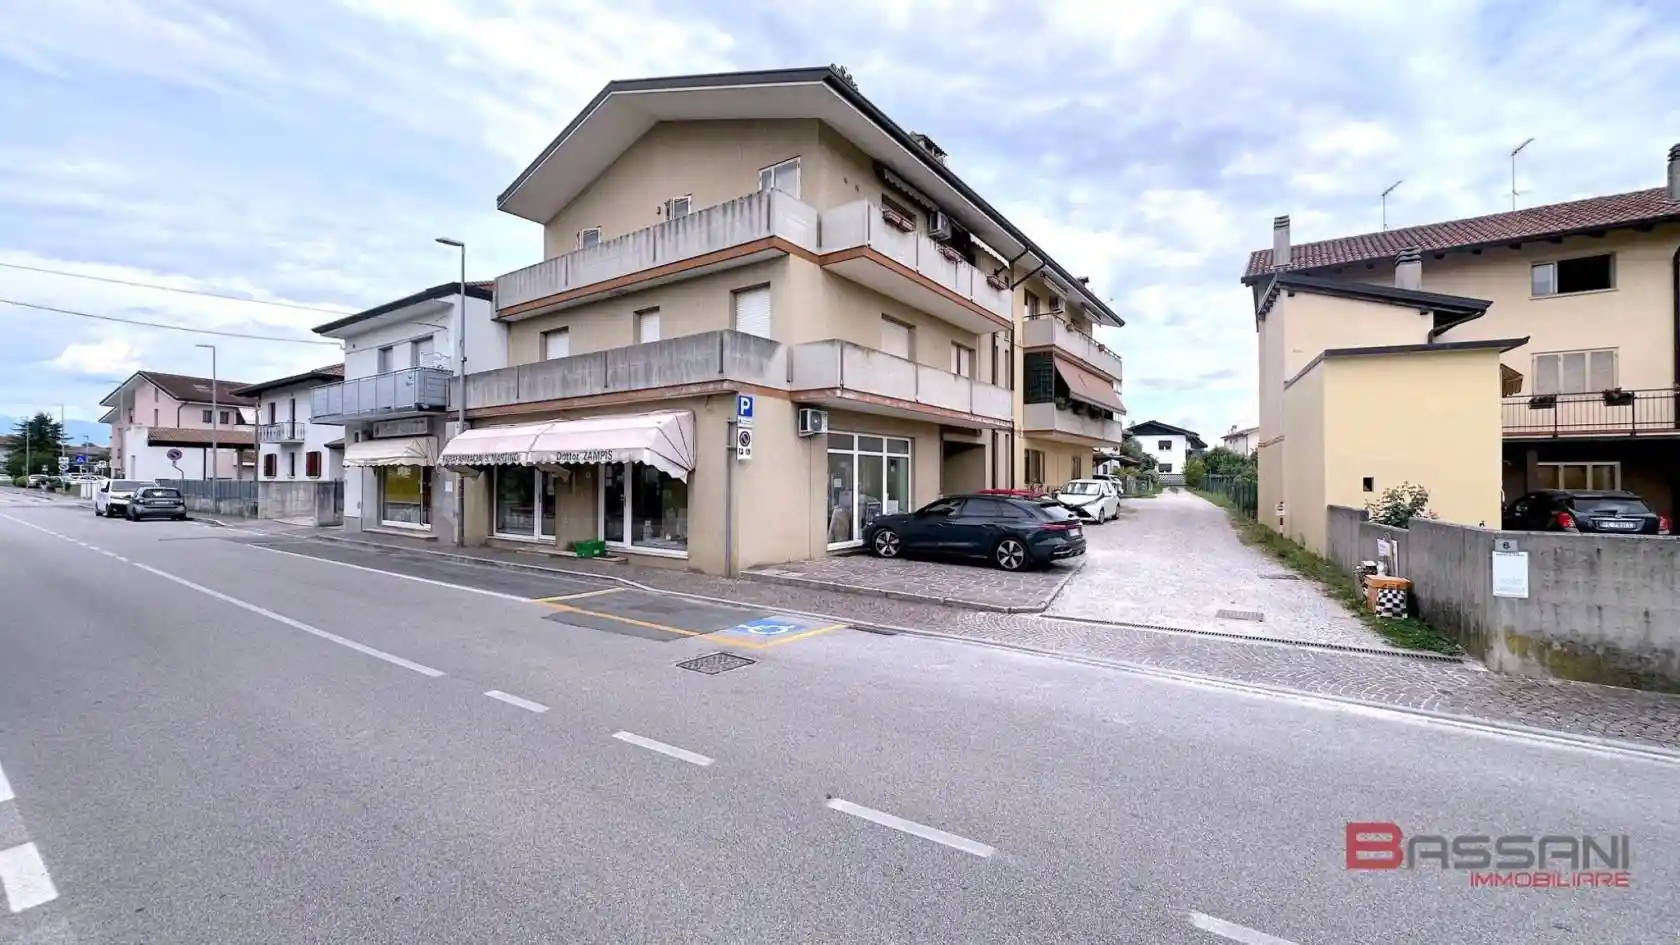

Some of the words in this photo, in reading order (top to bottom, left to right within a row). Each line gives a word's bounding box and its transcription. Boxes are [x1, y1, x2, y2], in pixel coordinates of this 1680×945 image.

[740, 397, 750, 415] P
[491, 451, 519, 462] MARTINO
[583, 449, 613, 461] ZAMPIS
